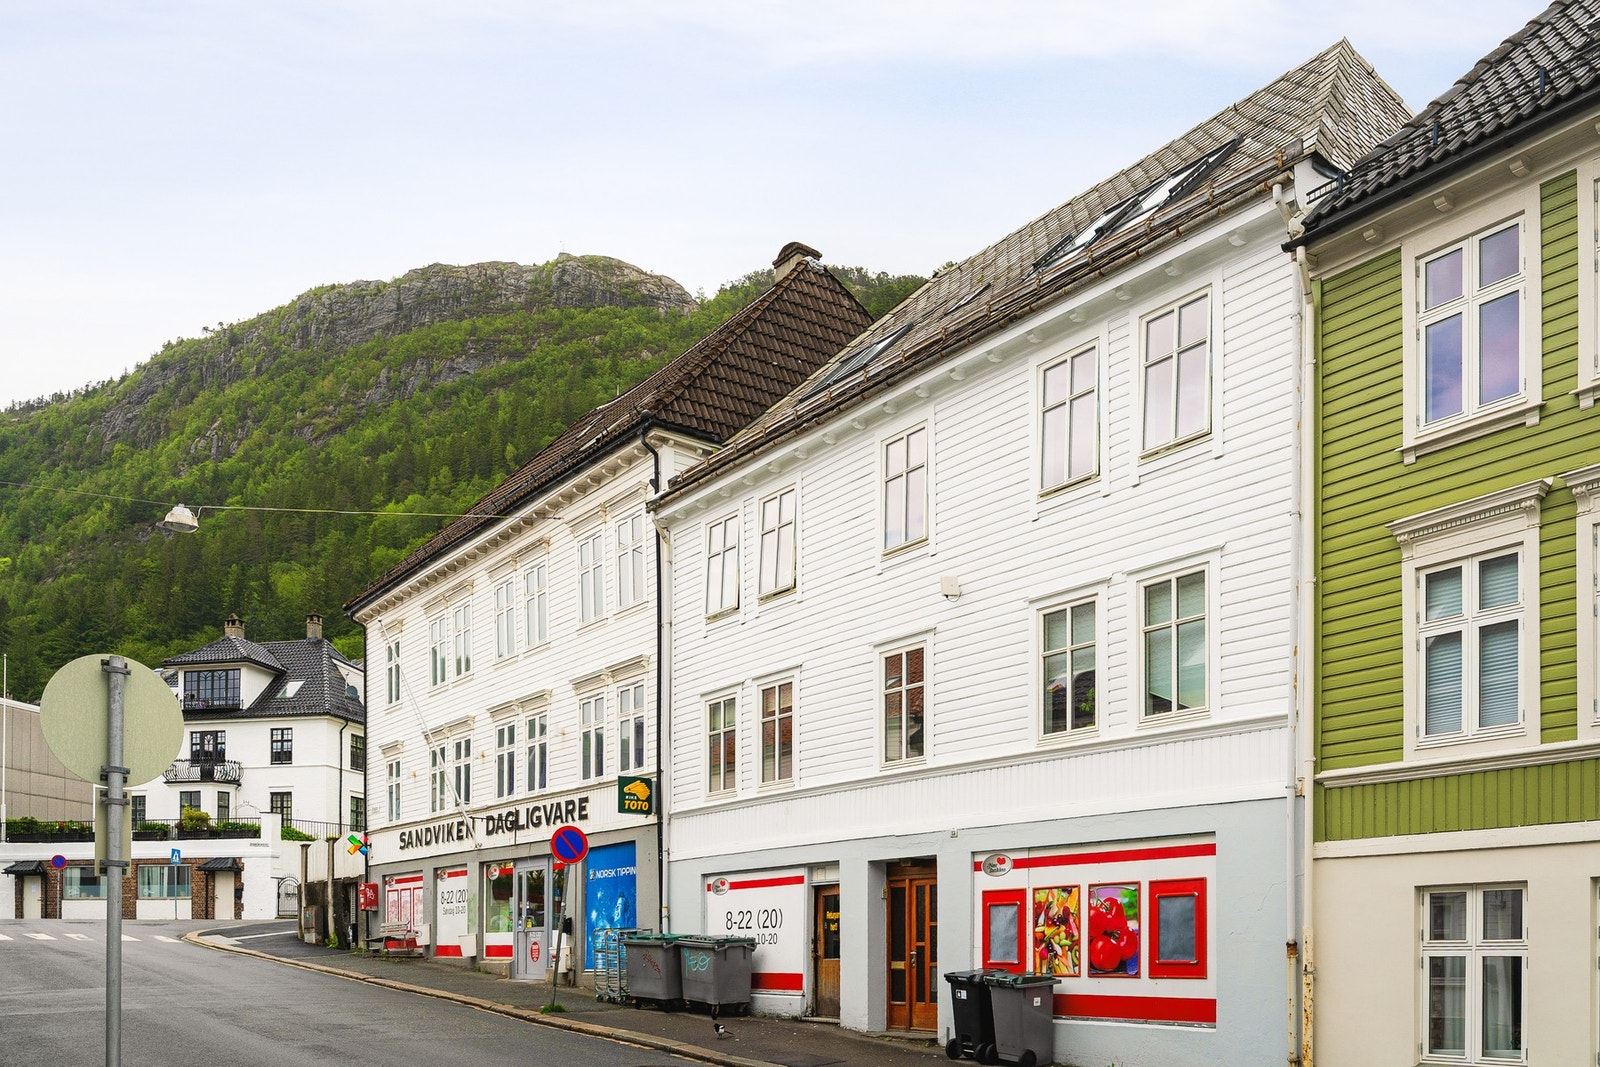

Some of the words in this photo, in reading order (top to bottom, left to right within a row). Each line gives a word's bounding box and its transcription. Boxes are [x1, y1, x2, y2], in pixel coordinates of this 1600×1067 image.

[624, 800, 649, 811] TOTO
[399, 818, 475, 850] SANDVIKEN
[485, 796, 589, 836] DAGLIGVARE
[596, 869, 617, 879] NORSK
[440, 890, 454, 905] 8-22
[725, 910, 753, 931] 8-22
[756, 908, 783, 930] (20)
[756, 932, 778, 945] 10-20
